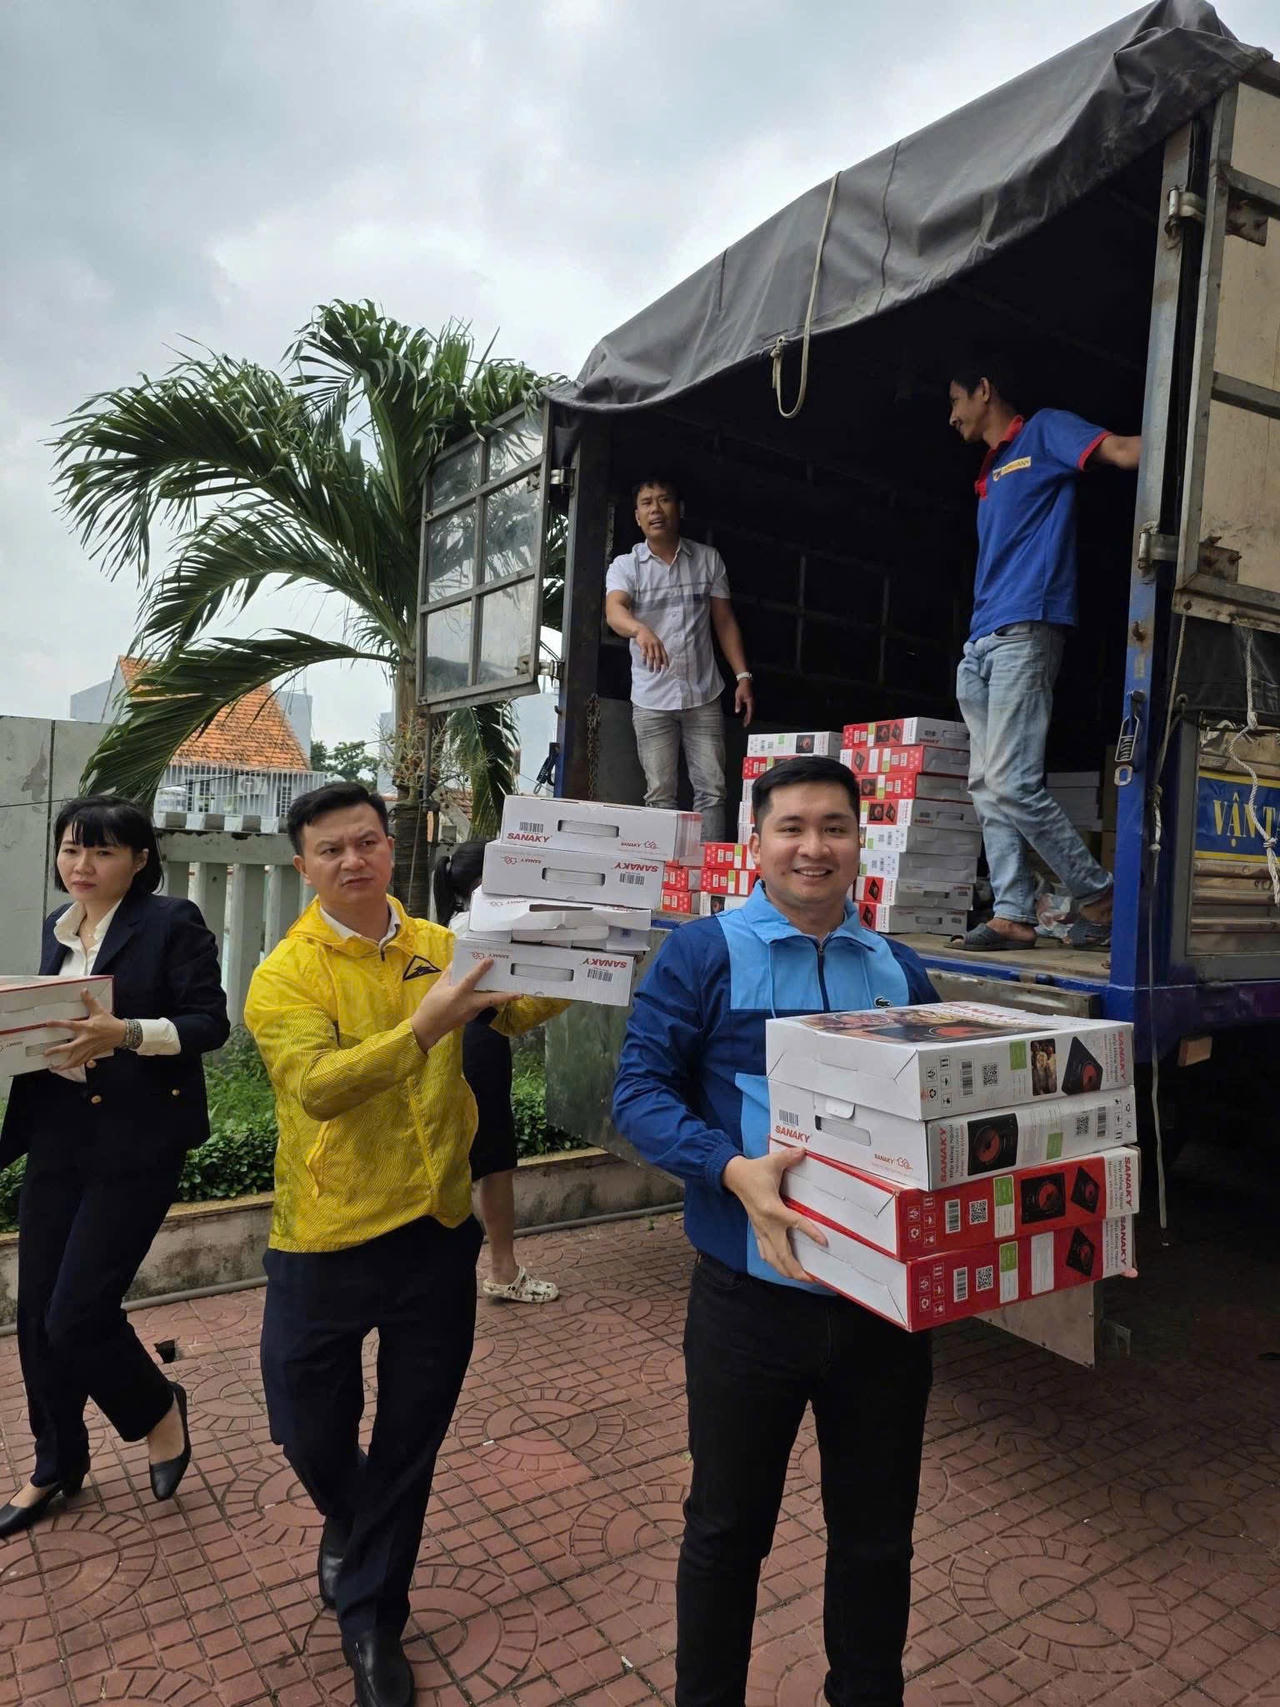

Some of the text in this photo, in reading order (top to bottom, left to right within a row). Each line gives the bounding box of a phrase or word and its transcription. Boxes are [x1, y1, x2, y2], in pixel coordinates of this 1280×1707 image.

[1213, 792, 1280, 848] VẬN T
[507, 833, 550, 843] SANAKY
[614, 861, 659, 872] SANAKY
[582, 957, 627, 968] SANAKY
[775, 1125, 810, 1143] SANAKY
[939, 1127, 948, 1183] SANAKY
[1124, 1156, 1133, 1207] SANAKY
